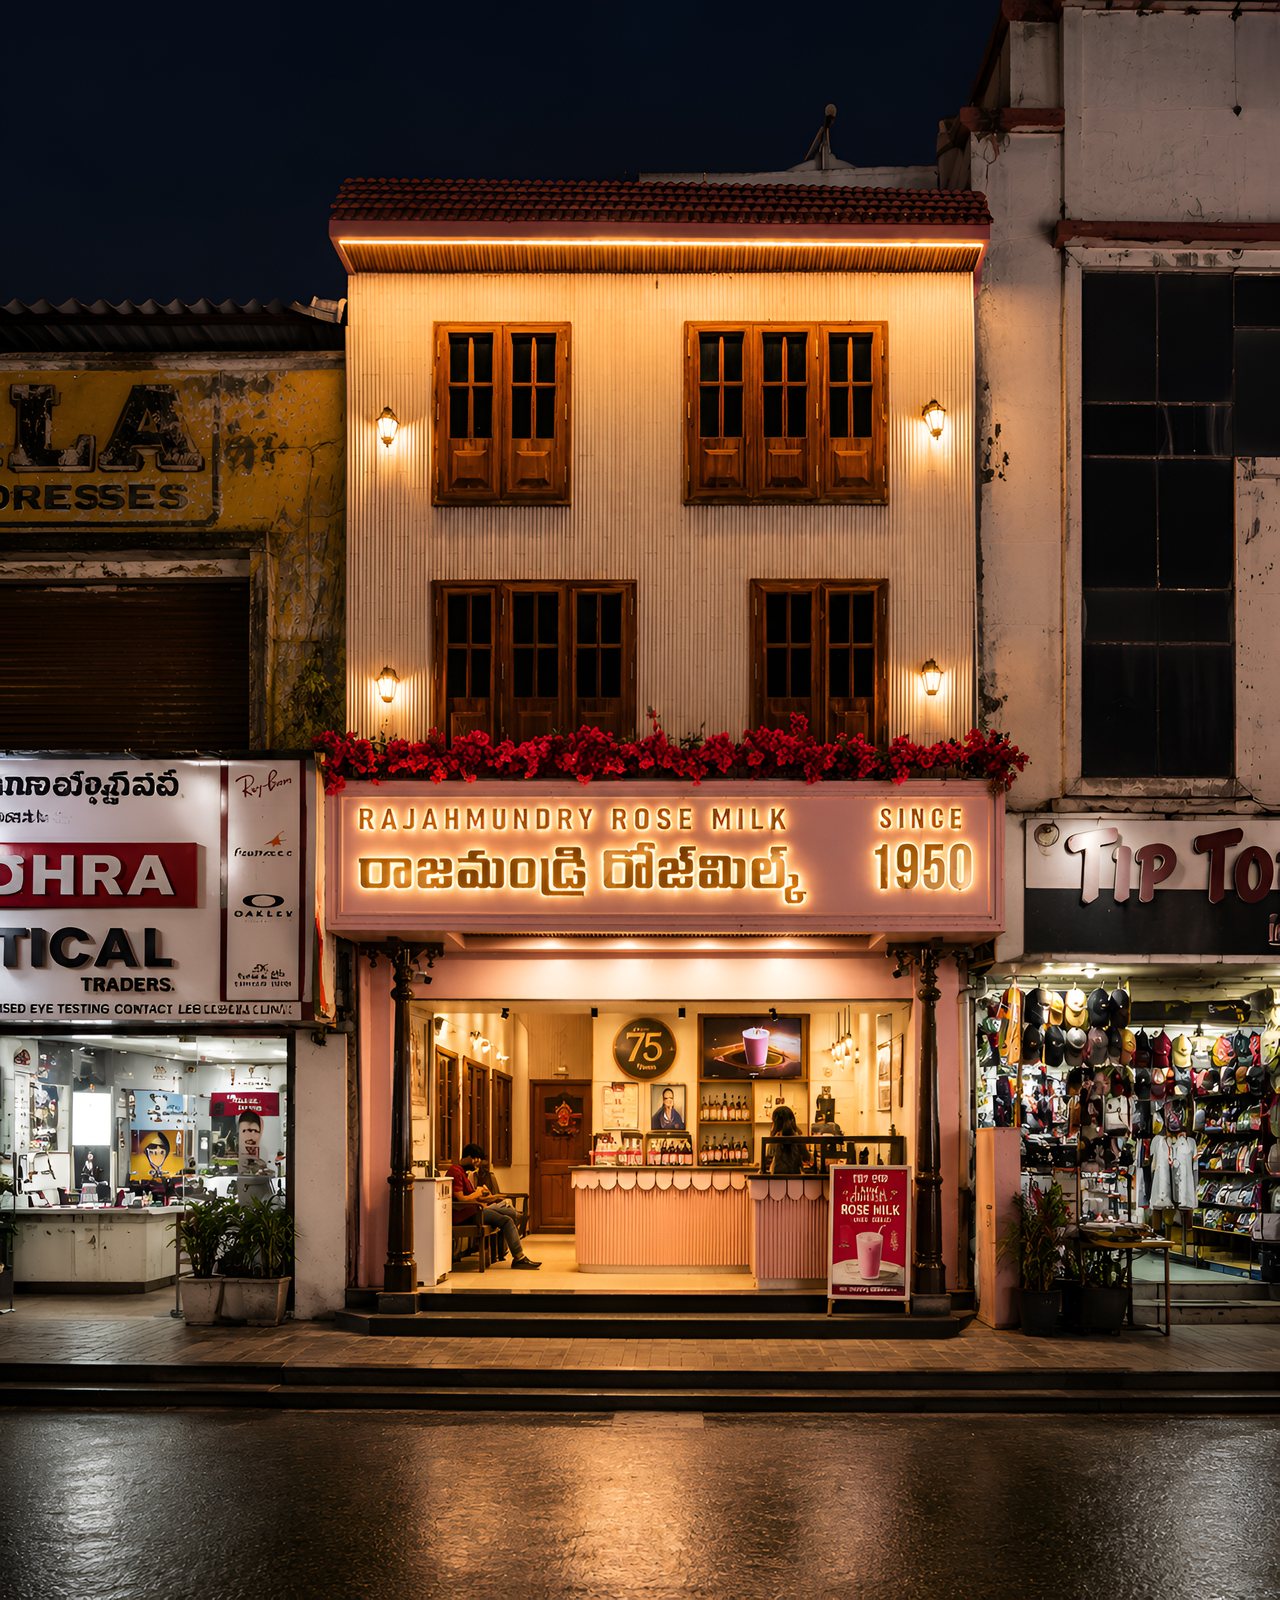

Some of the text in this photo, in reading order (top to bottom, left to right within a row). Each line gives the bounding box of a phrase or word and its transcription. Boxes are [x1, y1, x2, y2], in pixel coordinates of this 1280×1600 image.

[358, 807, 787, 831] RAJAHMUNDRY ROSE MILK
[880, 807, 962, 829] SINCE
[874, 843, 973, 890] 1950
[1193, 827, 1280, 905] TO
[30, 1003, 54, 1014] EYE
[57, 1003, 110, 1014] TESTING
[114, 1004, 173, 1015] CONTACT
[626, 1031, 663, 1062] 75
[841, 1203, 870, 1216] ROSE
